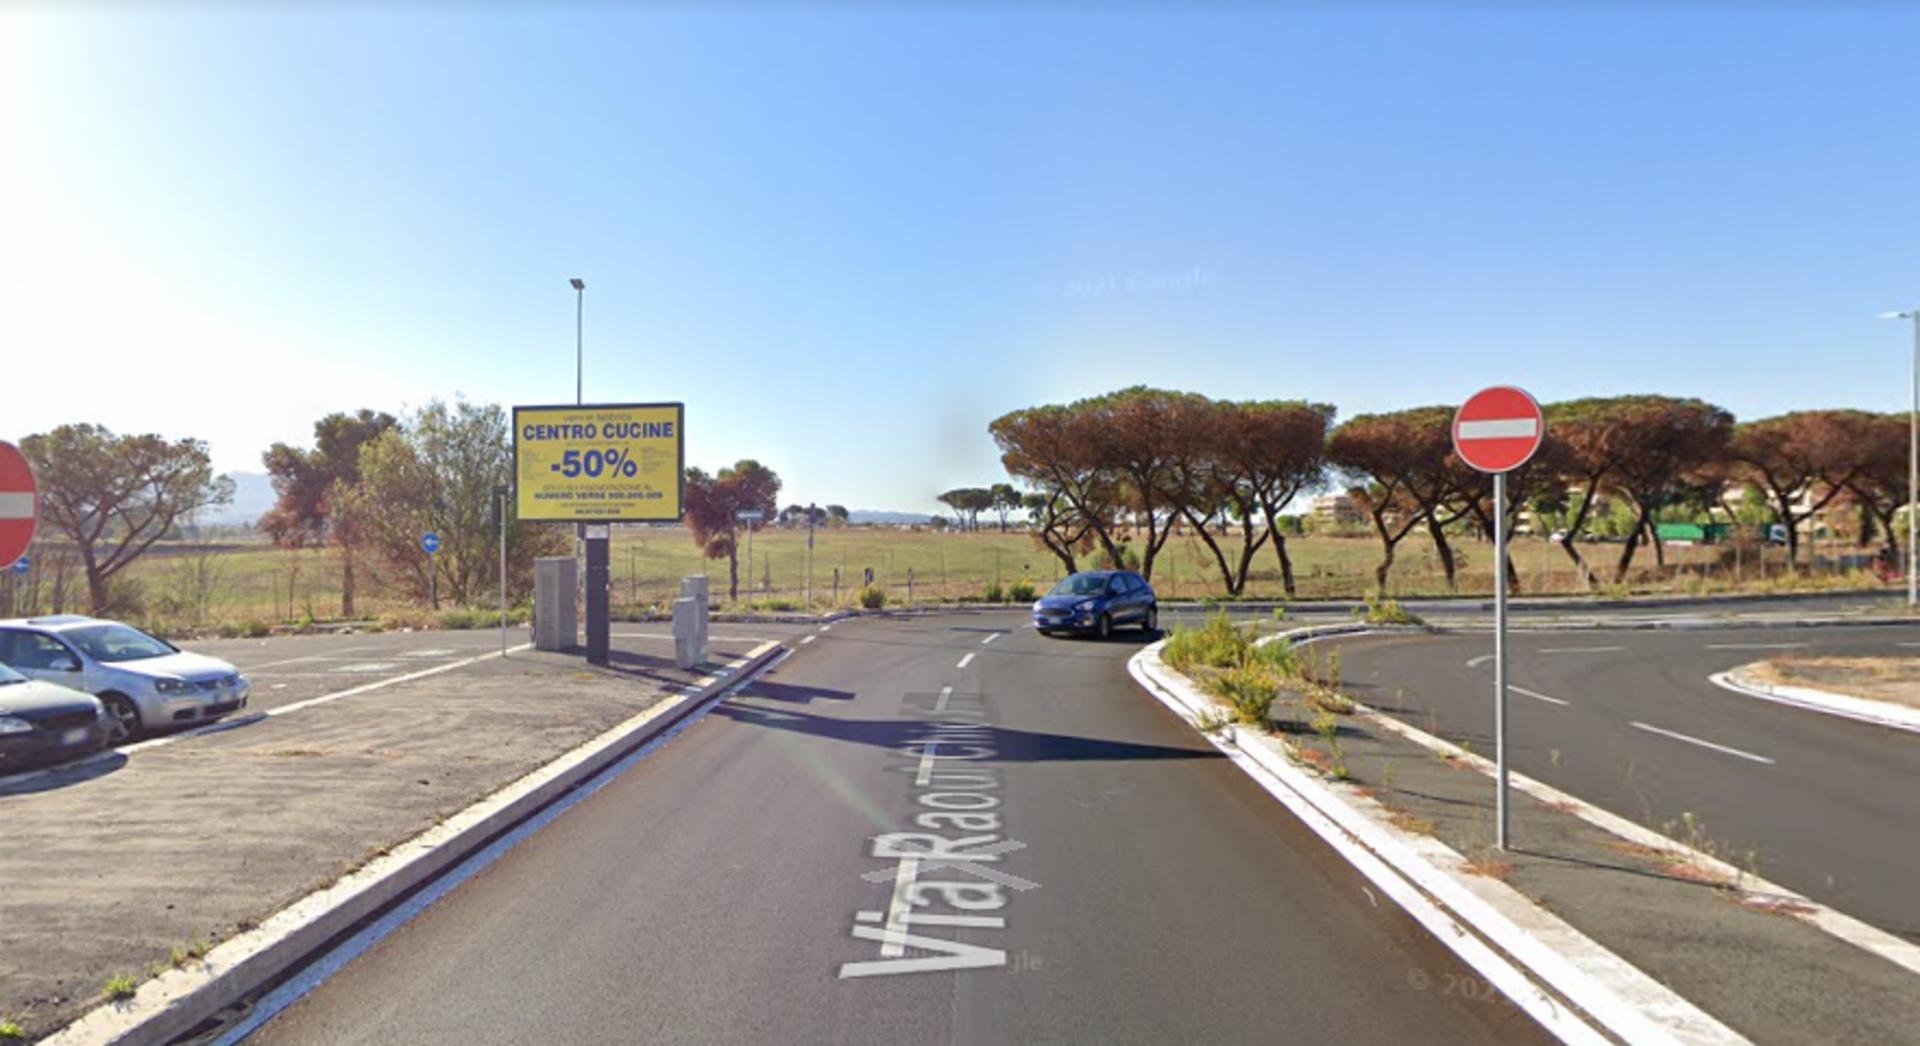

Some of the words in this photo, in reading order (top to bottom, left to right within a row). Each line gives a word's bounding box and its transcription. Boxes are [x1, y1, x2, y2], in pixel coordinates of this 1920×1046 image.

[523, 423, 597, 440] CENTRO
[603, 422, 674, 439] CUCINE
[551, 448, 637, 478] -50%
